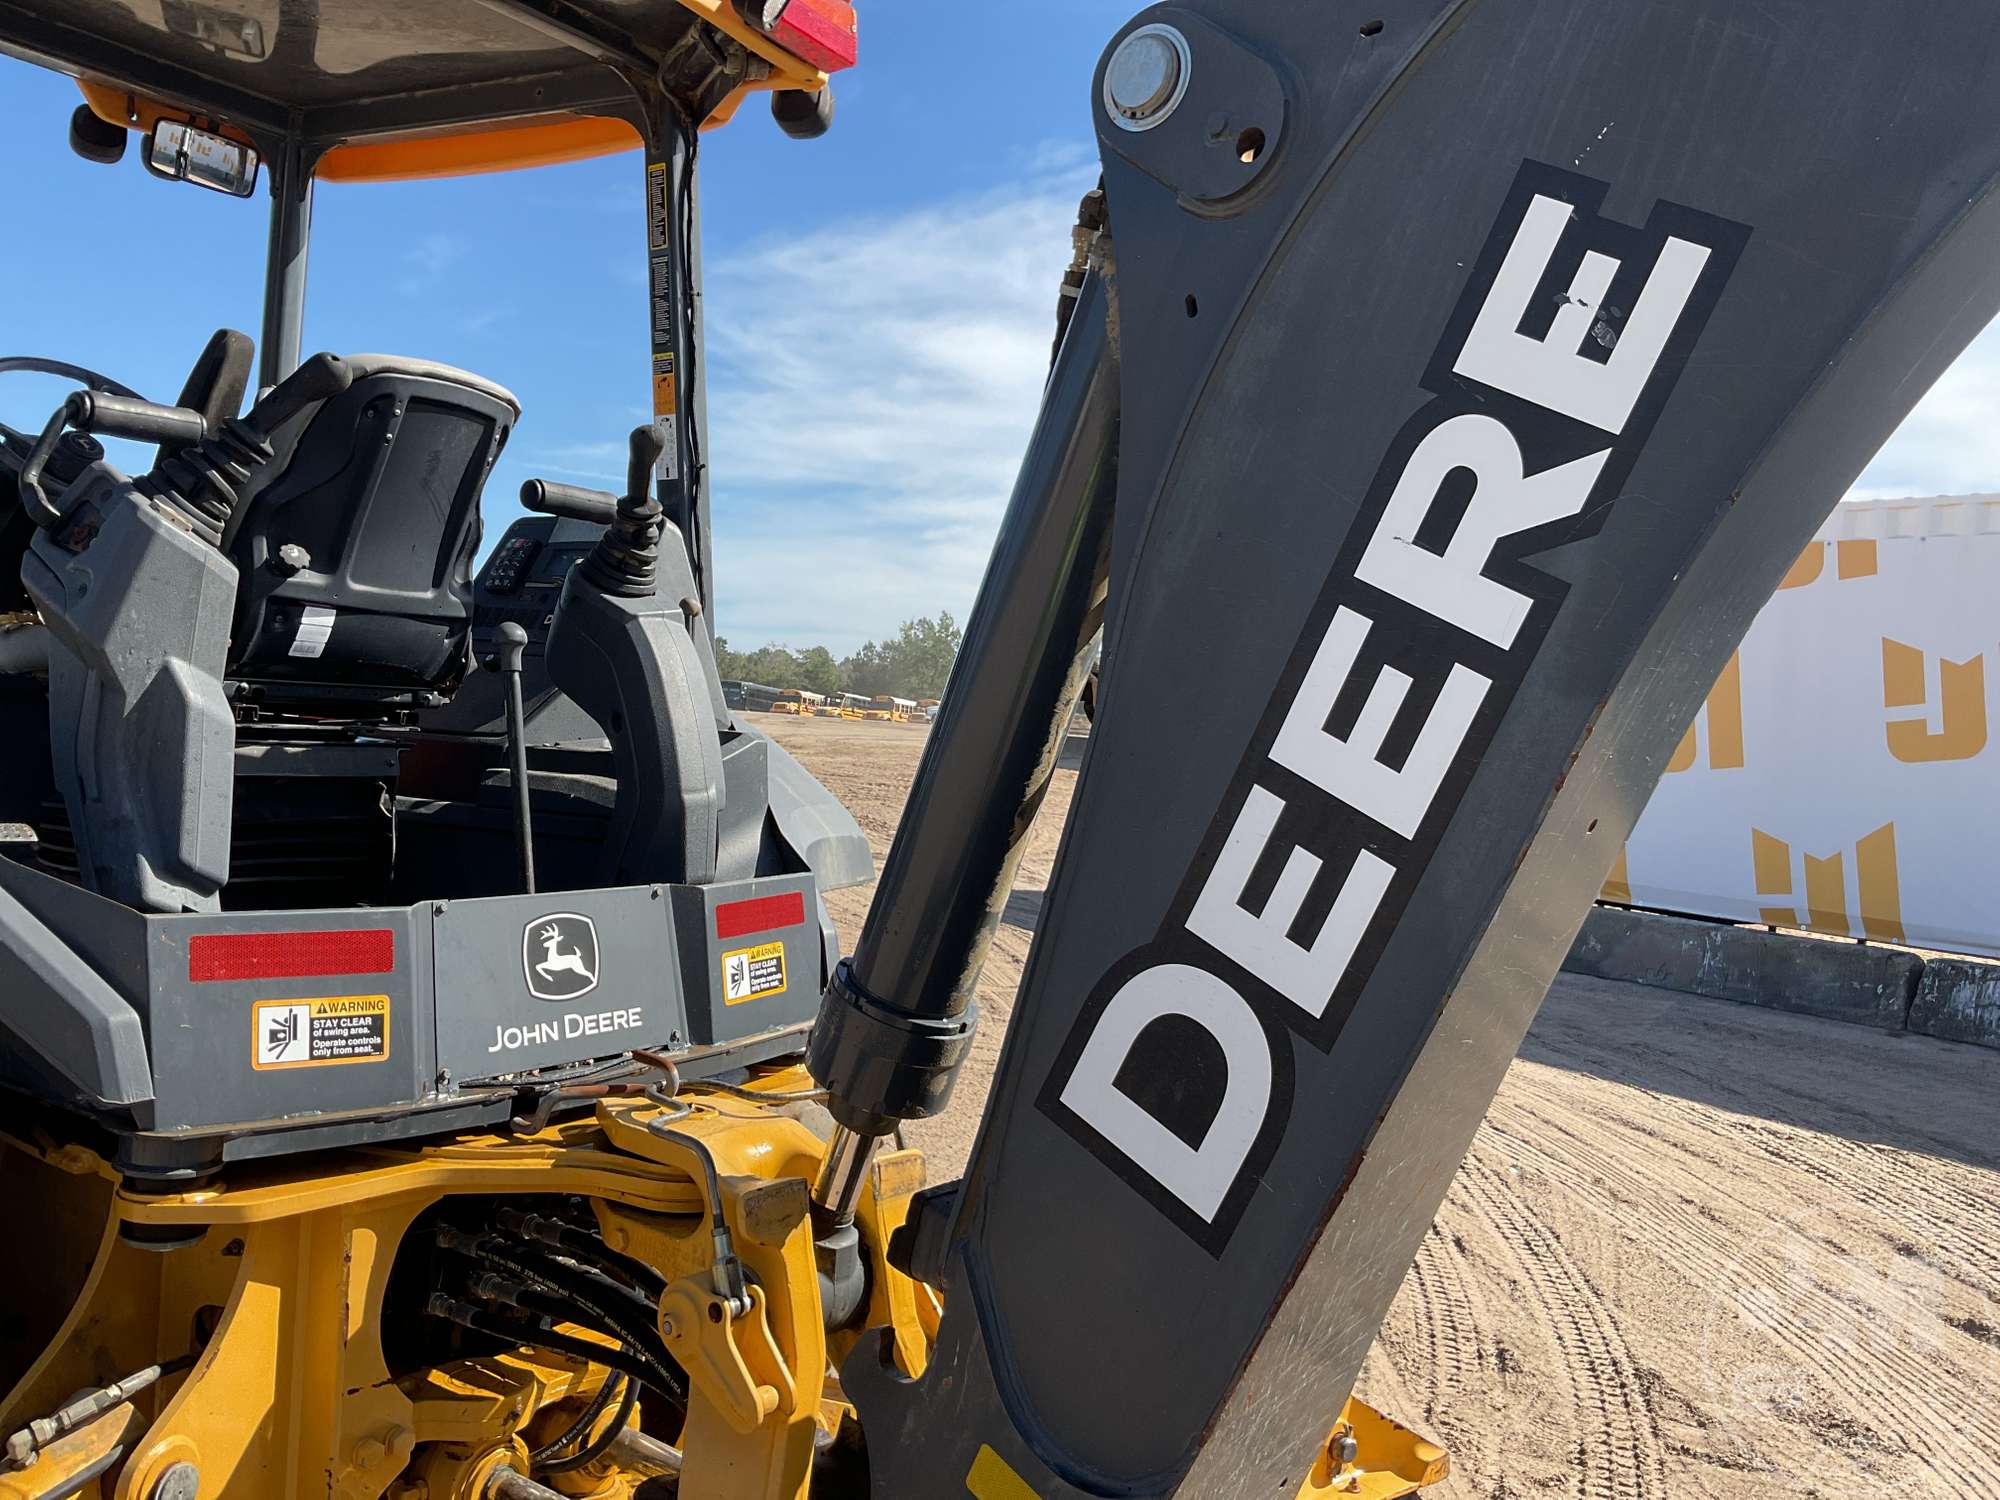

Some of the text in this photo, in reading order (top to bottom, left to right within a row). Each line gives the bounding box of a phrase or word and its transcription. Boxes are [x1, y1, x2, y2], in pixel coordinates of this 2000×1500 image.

[1059, 194, 1713, 1224] DEERE
[328, 1000, 385, 1013] WARNING
[313, 1017, 372, 1028] STAY CLEAR
[313, 1028, 322, 1036] of
[323, 1027, 349, 1037] swing
[488, 1007, 643, 1053] JOHN DEERE
[313, 1036, 382, 1048] Operate controls
[313, 1045, 374, 1056] only from seat.
